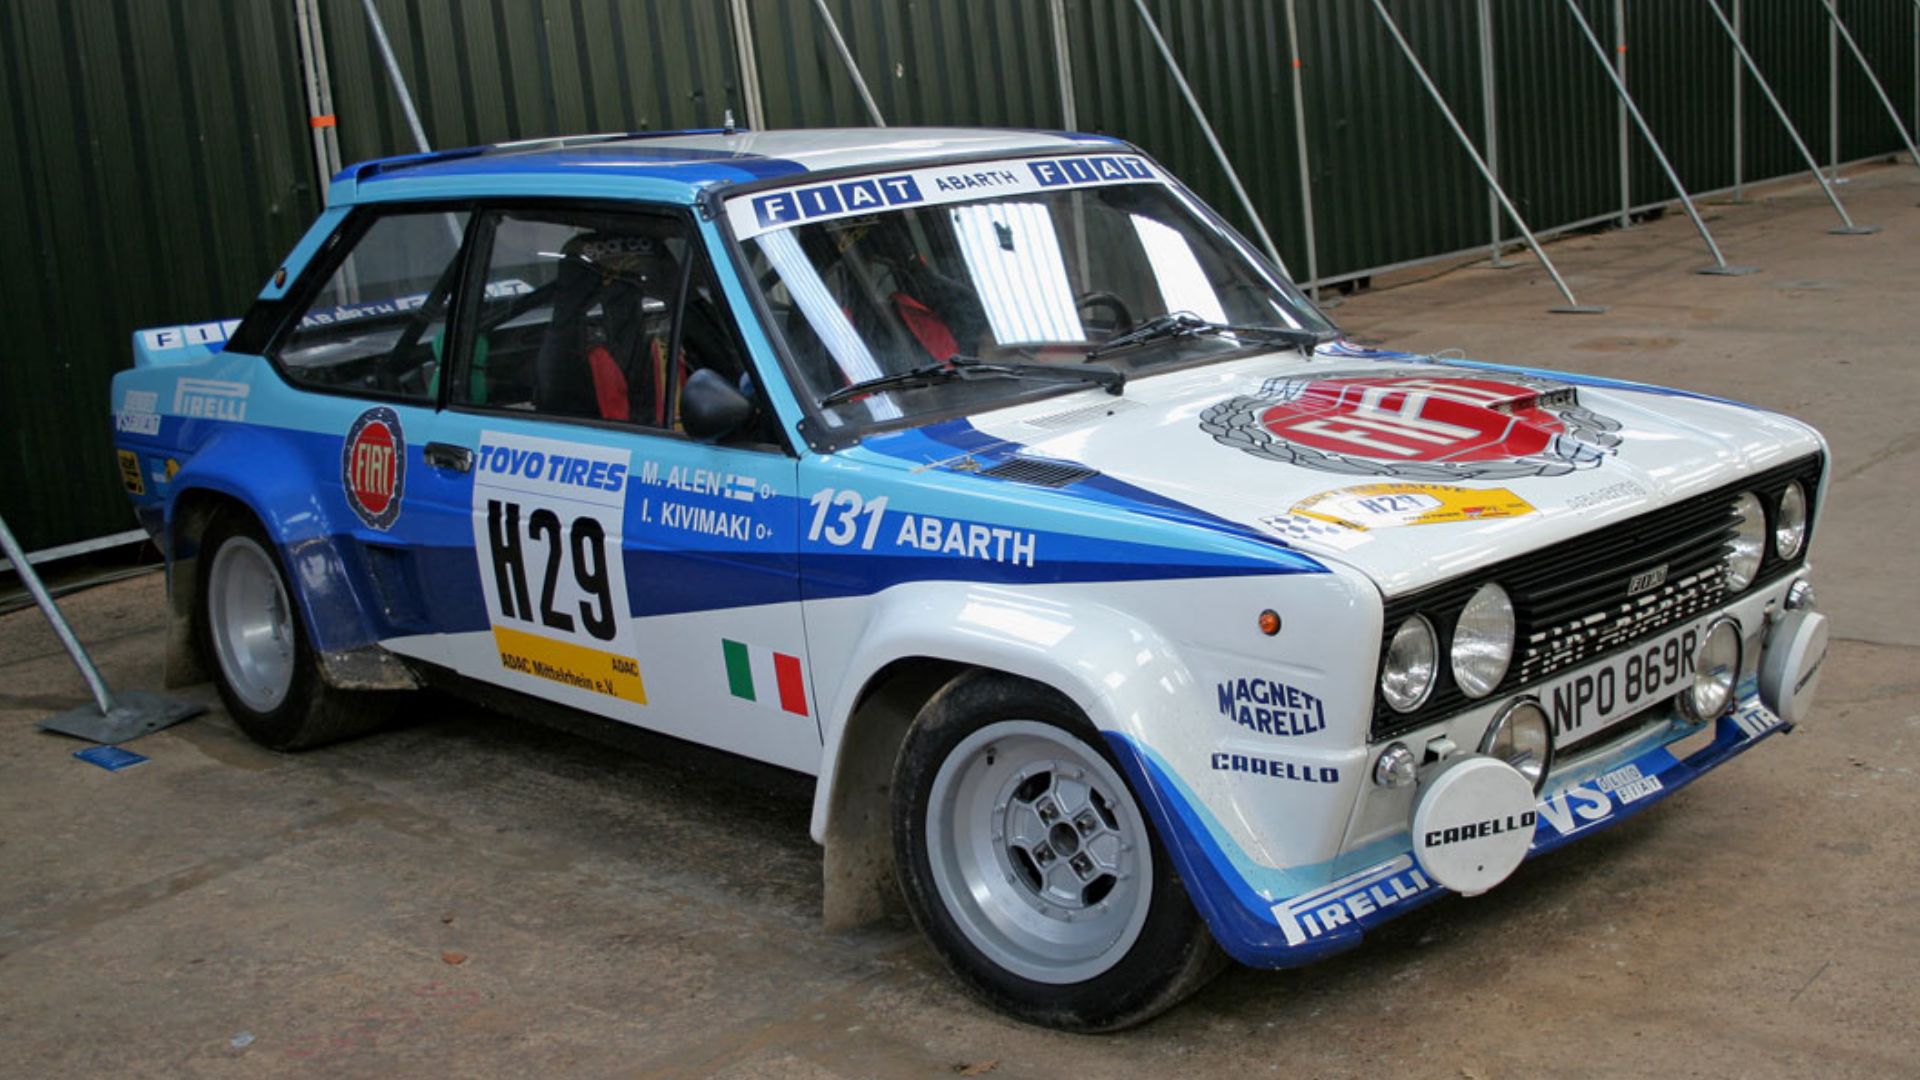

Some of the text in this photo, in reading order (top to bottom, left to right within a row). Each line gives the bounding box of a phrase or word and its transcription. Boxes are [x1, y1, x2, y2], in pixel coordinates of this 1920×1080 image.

[763, 156, 1145, 222] FIAT ABARTH FIAT
[173, 377, 250, 422] PIRELLI
[1286, 379, 1517, 457] FIAT
[356, 442, 392, 496] FIAT
[480, 445, 628, 492] TOYO TIRES
[641, 460, 662, 486] M.
[667, 465, 721, 496] ALEN
[642, 498, 652, 522] I.
[661, 501, 751, 541] KIVIMAKI
[1356, 493, 1426, 514] H29
[808, 488, 1035, 568] 131 ABARTH
[488, 499, 617, 641] H29
[501, 652, 531, 674] ADAC
[612, 657, 639, 677] ADAC
[1554, 628, 1697, 737] NPO 869R
[1217, 678, 1326, 722] MAGNETI
[1217, 690, 1326, 736] MARELLI
[1211, 752, 1339, 782] CARELLO
[1425, 811, 1536, 848] CARELLO
[1271, 855, 1430, 945] PIRELLI
